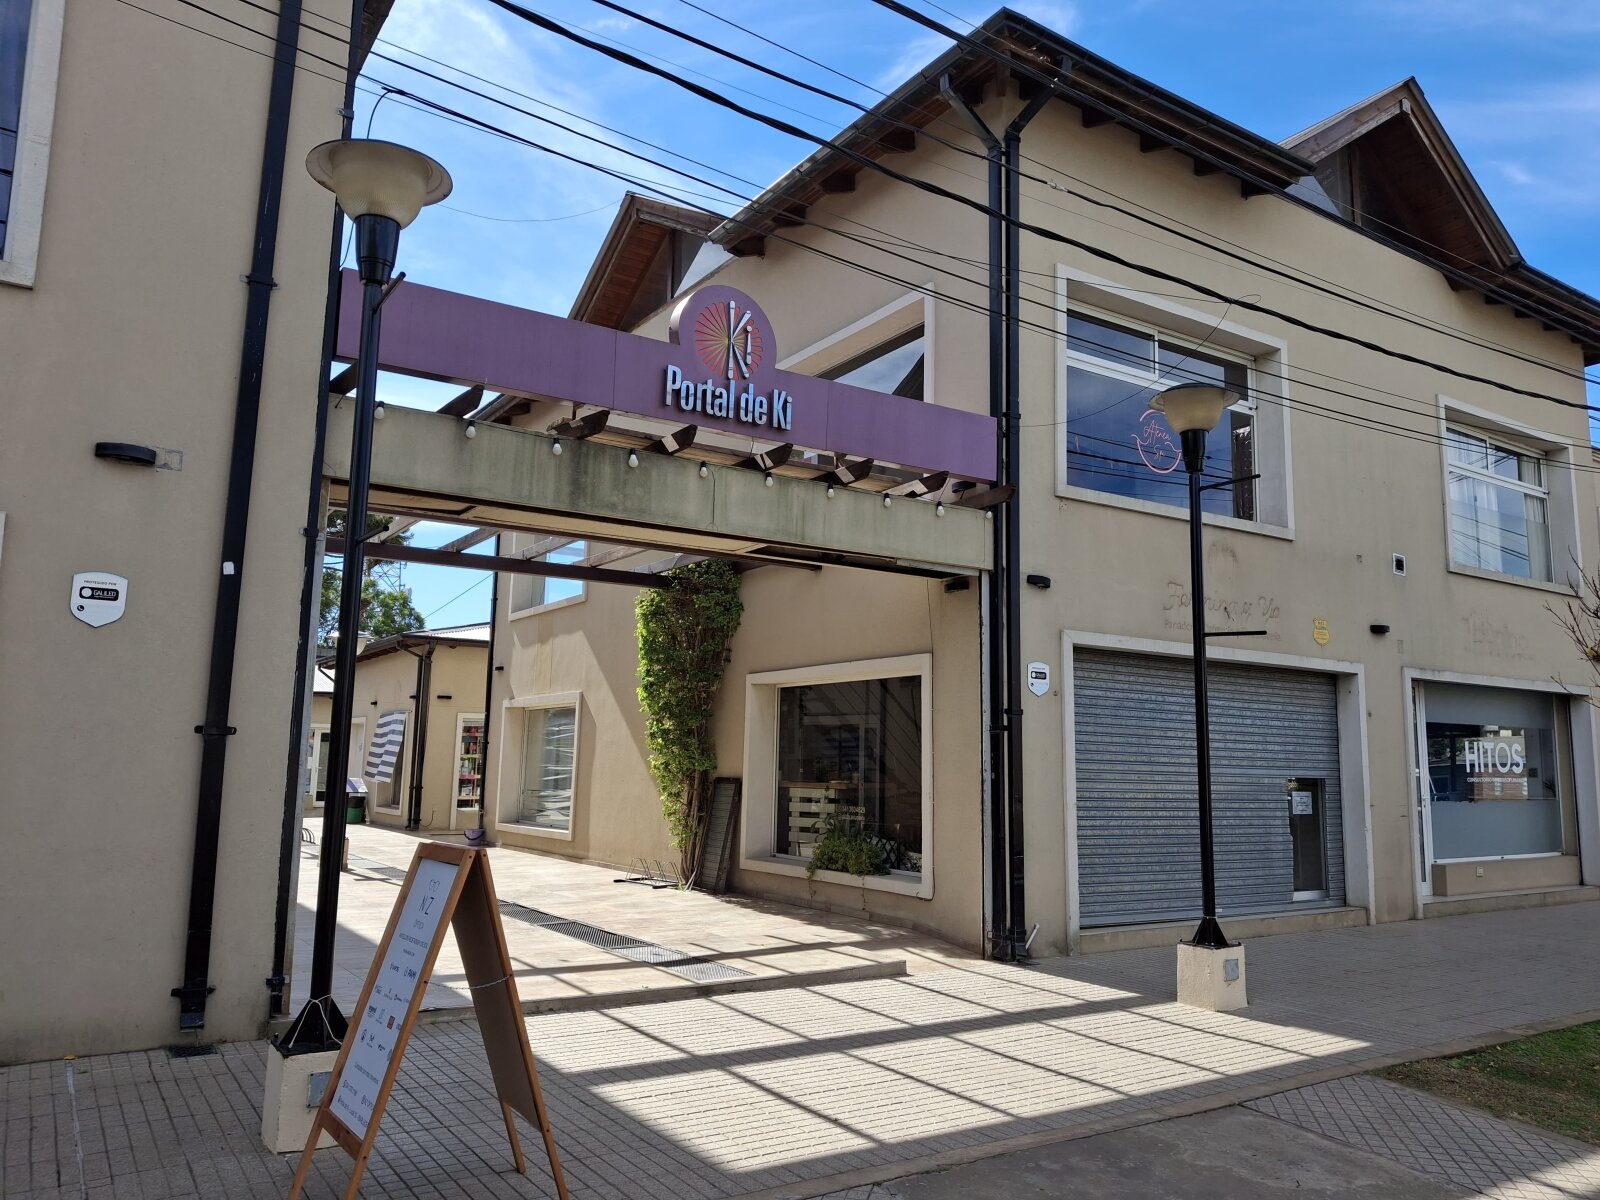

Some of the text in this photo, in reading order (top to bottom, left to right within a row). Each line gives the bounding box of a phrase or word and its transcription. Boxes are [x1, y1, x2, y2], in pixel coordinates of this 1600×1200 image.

[728, 301, 753, 379] Ki
[665, 364, 793, 431] Portal de Ki
[1464, 741, 1523, 773] HITOS
[418, 895, 435, 915] NZ
